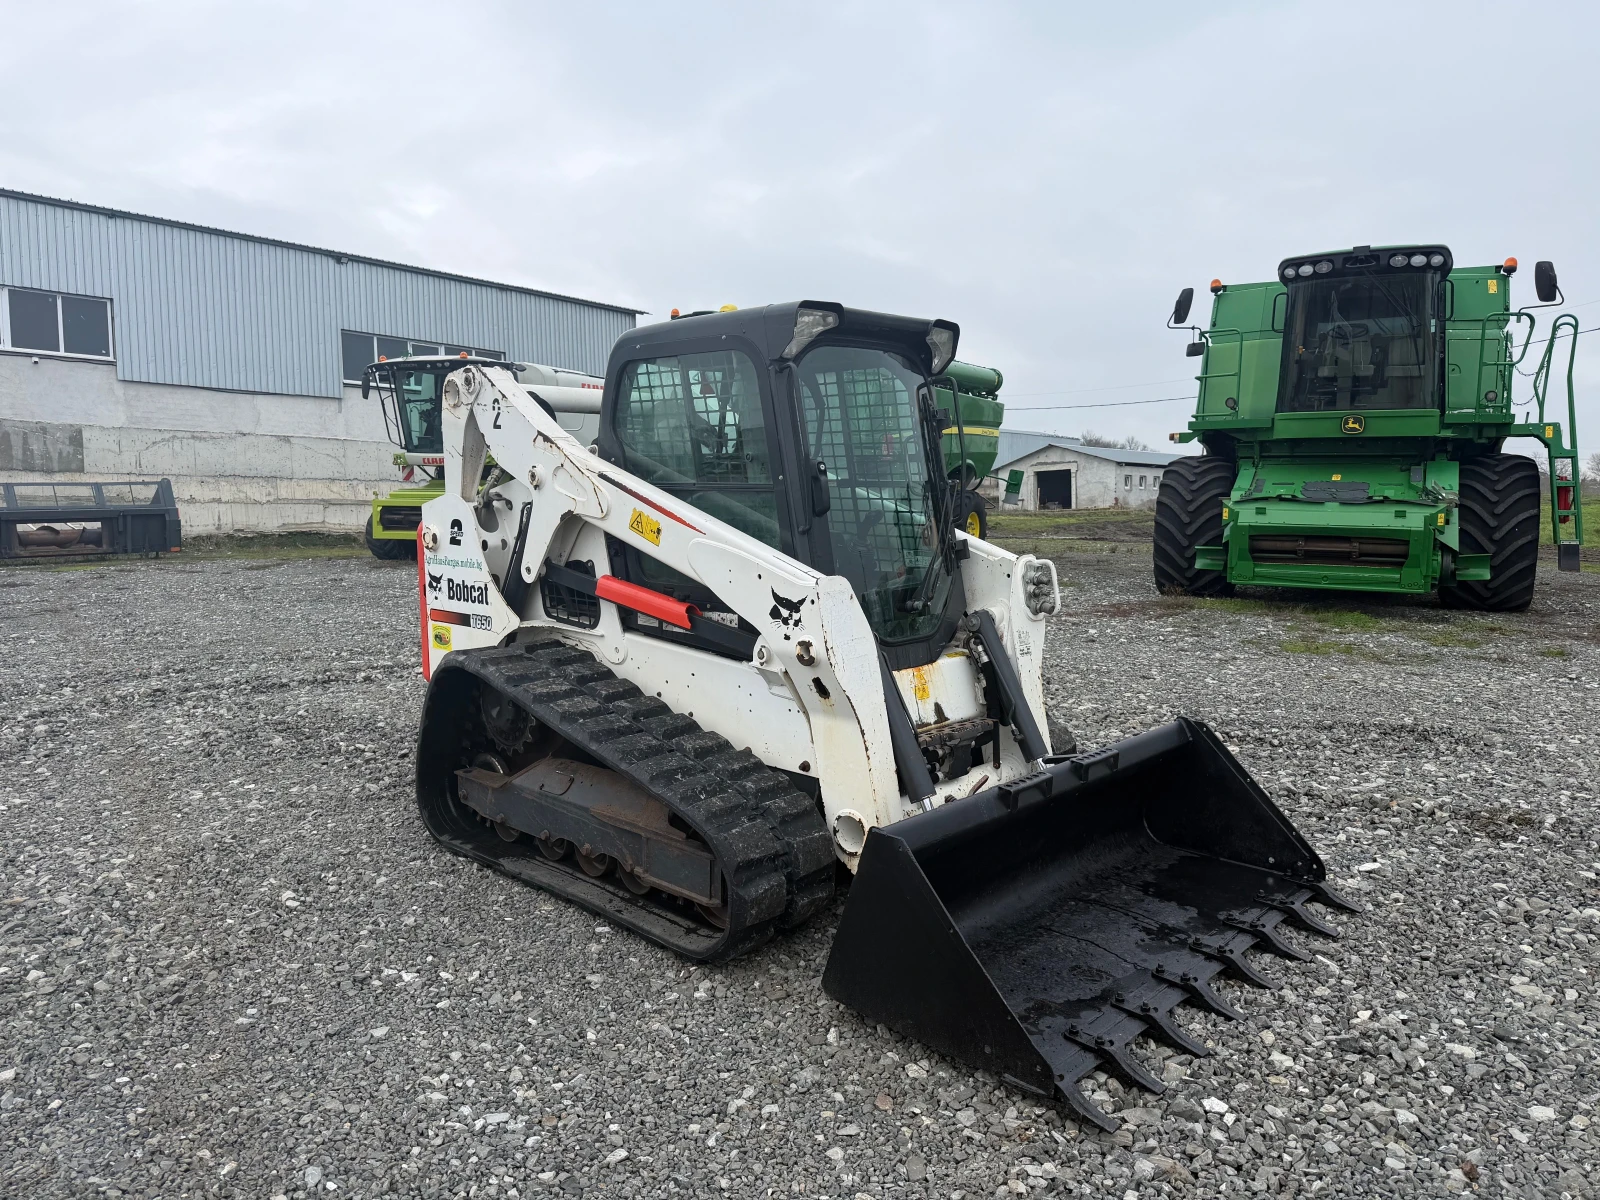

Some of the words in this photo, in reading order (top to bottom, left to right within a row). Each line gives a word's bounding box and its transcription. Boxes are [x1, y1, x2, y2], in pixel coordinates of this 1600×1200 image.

[492, 397, 502, 430] 2
[450, 530, 464, 538] SPEED
[447, 577, 489, 606] Bobcat
[471, 613, 493, 632] T650
